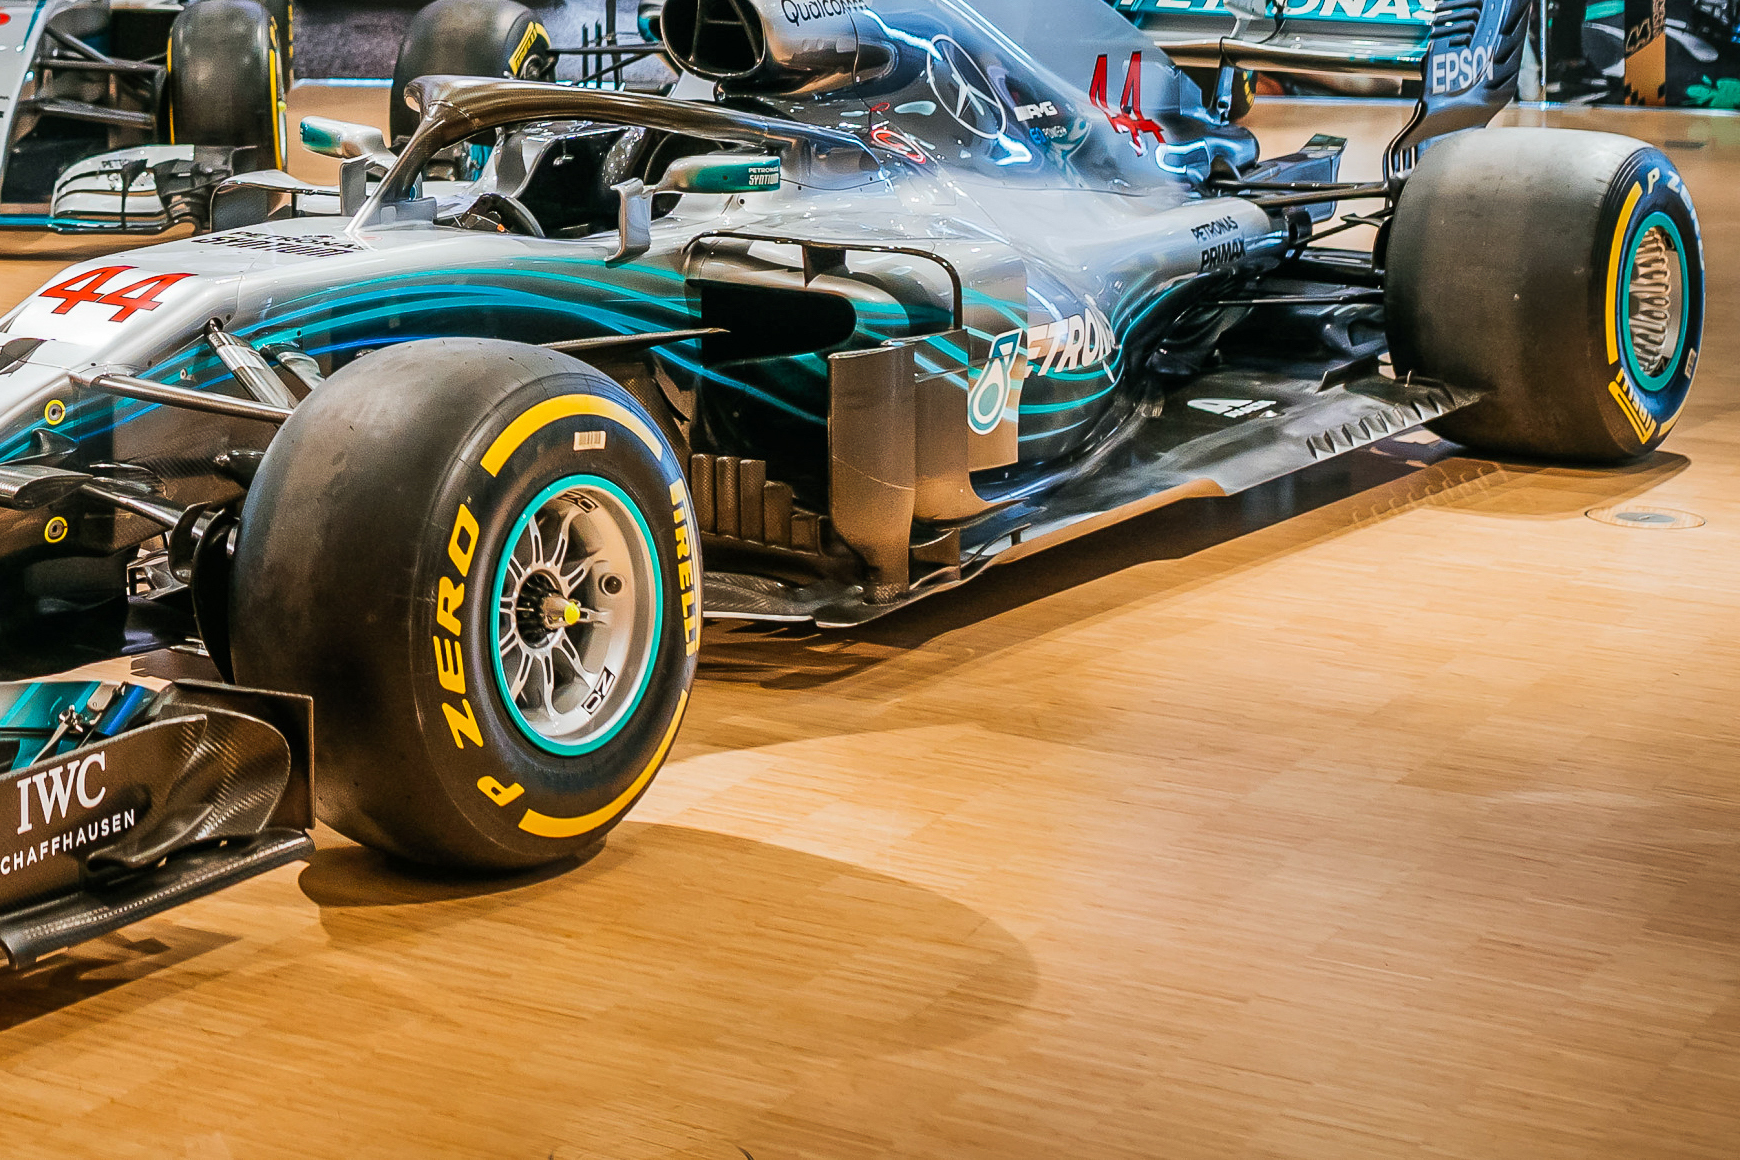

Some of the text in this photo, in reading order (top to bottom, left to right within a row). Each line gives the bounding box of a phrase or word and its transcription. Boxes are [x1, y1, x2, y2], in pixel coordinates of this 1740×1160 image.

[1431, 42, 1496, 94] EPSON
[1199, 236, 1247, 273] PRIMAX
[37, 264, 200, 323] 44
[432, 503, 485, 750] ZERO
[16, 750, 107, 836] IWC
